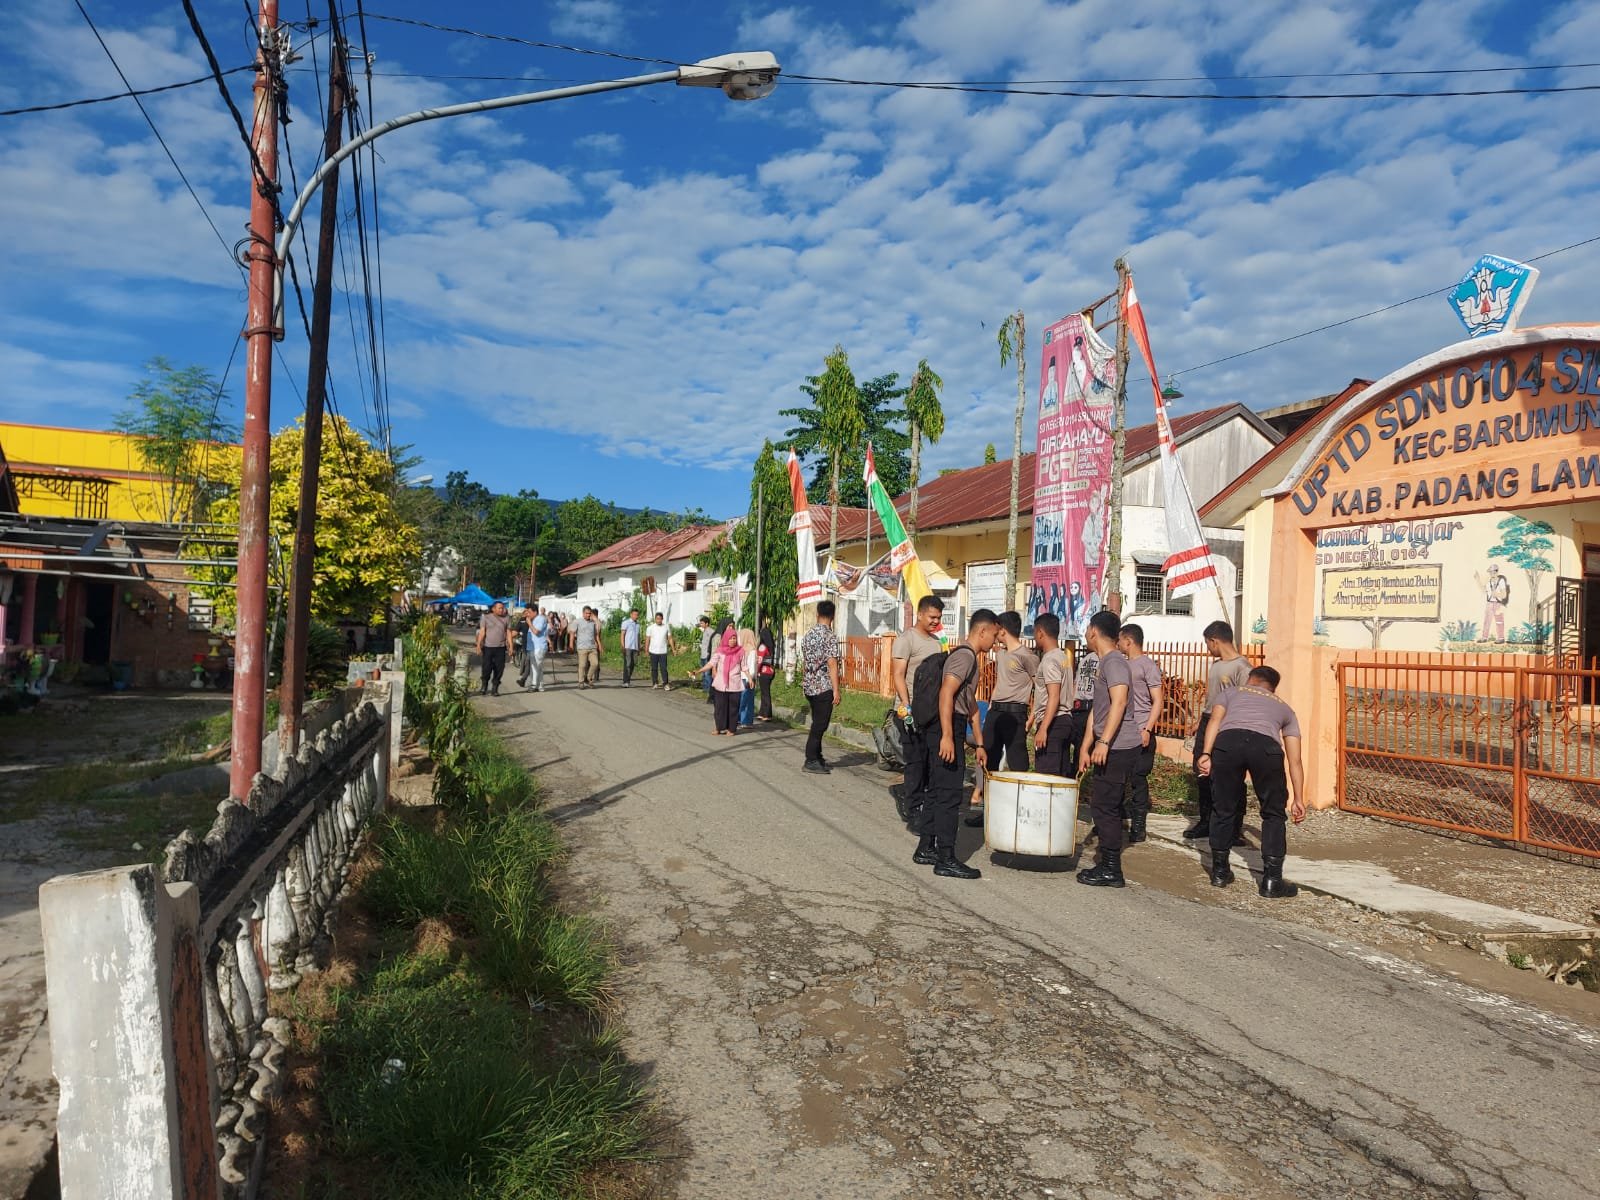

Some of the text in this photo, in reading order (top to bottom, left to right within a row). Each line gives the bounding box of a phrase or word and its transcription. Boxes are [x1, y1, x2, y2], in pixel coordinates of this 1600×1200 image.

[1040, 427, 1106, 456] DIRGAHAYU
[1292, 423, 1371, 516] UPTD
[1375, 373, 1447, 440] SDN
[1451, 352, 1545, 408] 0104
[1039, 449, 1079, 486] PGRI
[1531, 454, 1600, 493] LAW
[1378, 519, 1464, 549] Belajar
[1335, 549, 1384, 564] NEGERI
[1391, 546, 1429, 561] 0104
